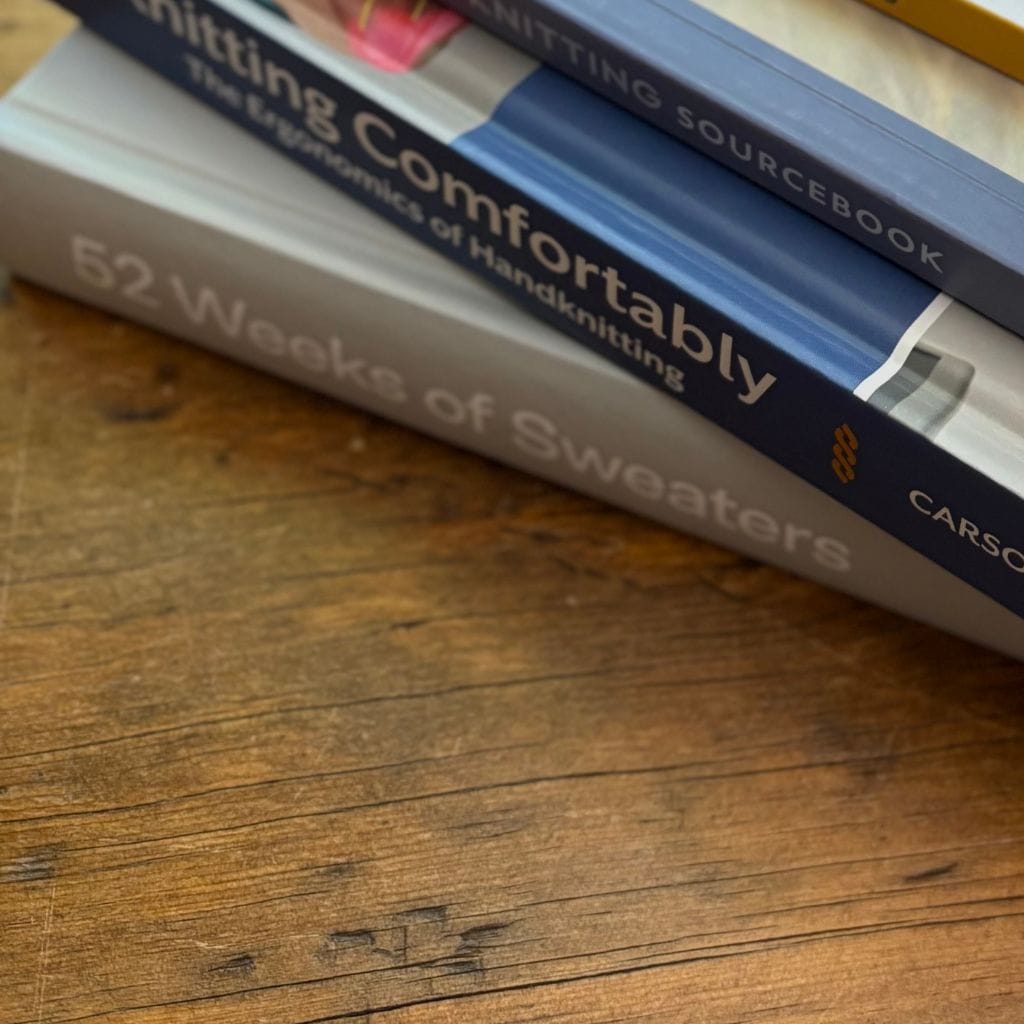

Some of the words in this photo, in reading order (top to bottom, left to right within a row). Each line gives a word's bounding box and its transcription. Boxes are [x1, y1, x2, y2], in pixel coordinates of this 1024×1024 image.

[182, 53, 236, 107] The
[246, 88, 425, 222] Ergonomics
[431, 215, 465, 248] of
[469, 233, 686, 394] Handknitting
[353, 113, 779, 405] Comfortably
[676, 104, 948, 275] SOURCEBOOK
[71, 234, 161, 311] 52
[171, 274, 408, 406] Weeks
[423, 384, 495, 434] of
[511, 408, 853, 574] Sweaters
